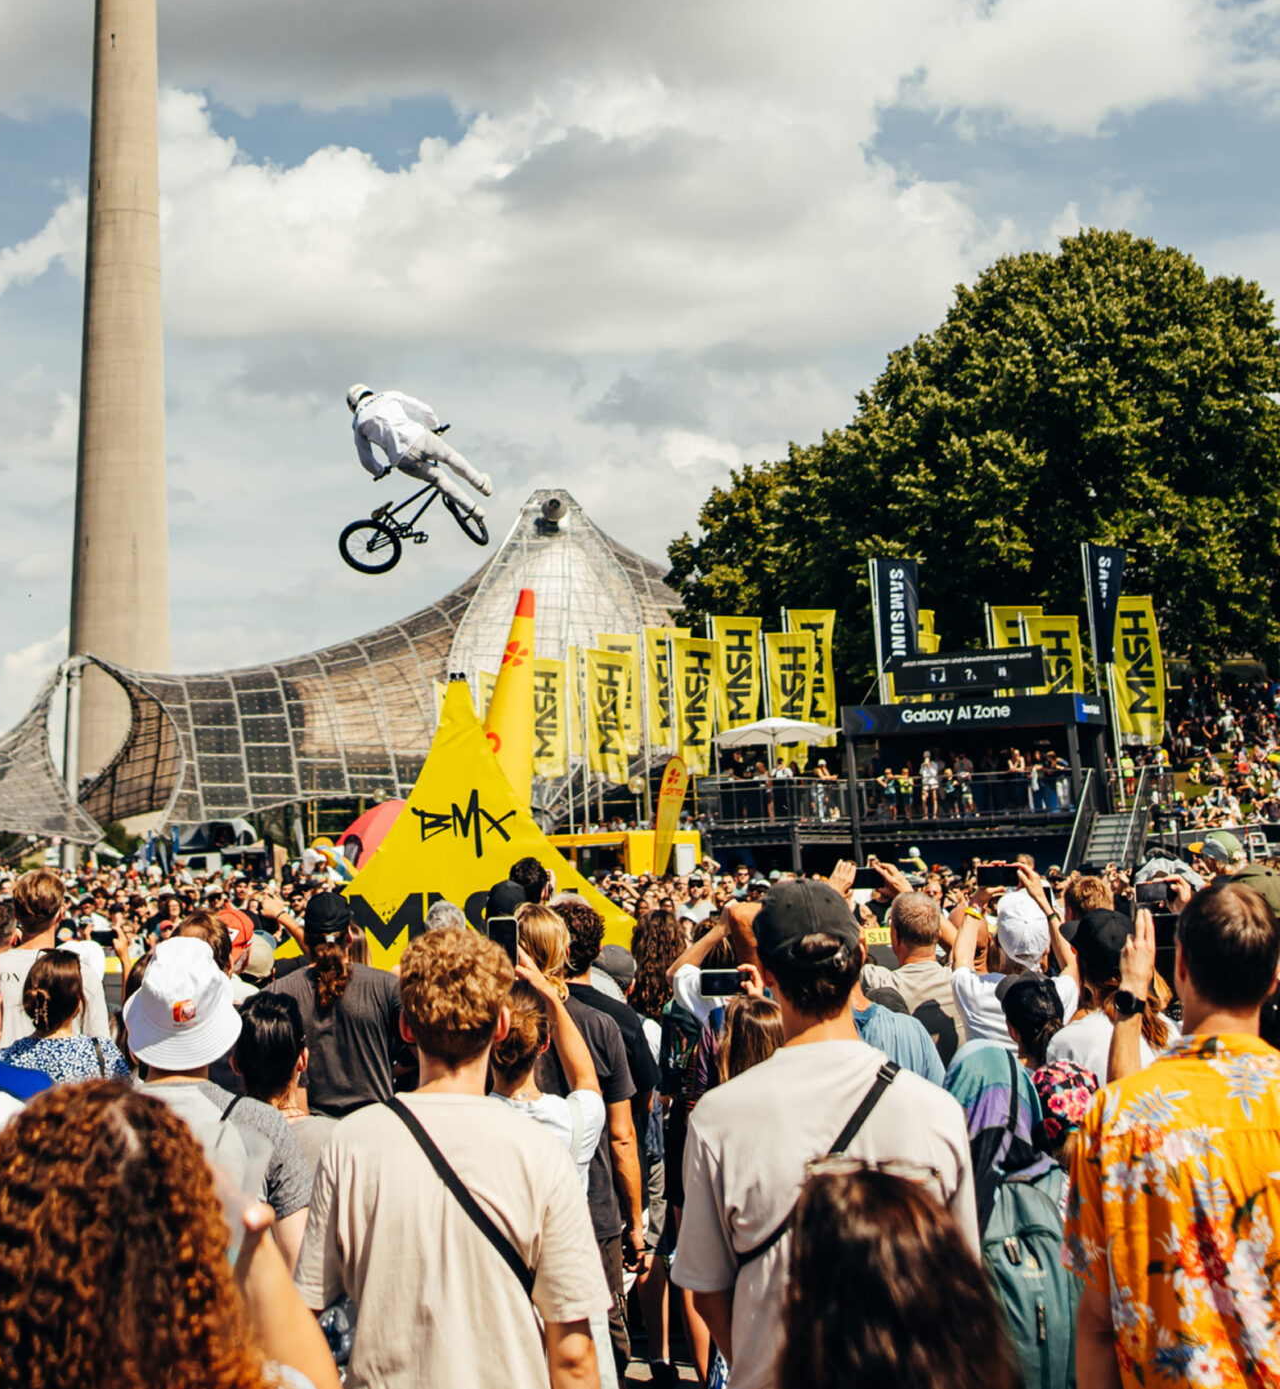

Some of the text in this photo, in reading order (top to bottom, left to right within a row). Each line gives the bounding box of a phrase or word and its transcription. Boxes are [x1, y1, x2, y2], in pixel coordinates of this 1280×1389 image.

[685, 650, 711, 746] MASH
[725, 629, 752, 722] MASH
[1120, 610, 1158, 715] MASH
[533, 670, 558, 758] MASH
[597, 662, 623, 755] MASH
[901, 705, 1011, 725] Galaxy AI Zone
[412, 789, 516, 859] BMX
[868, 931, 887, 943] SU
